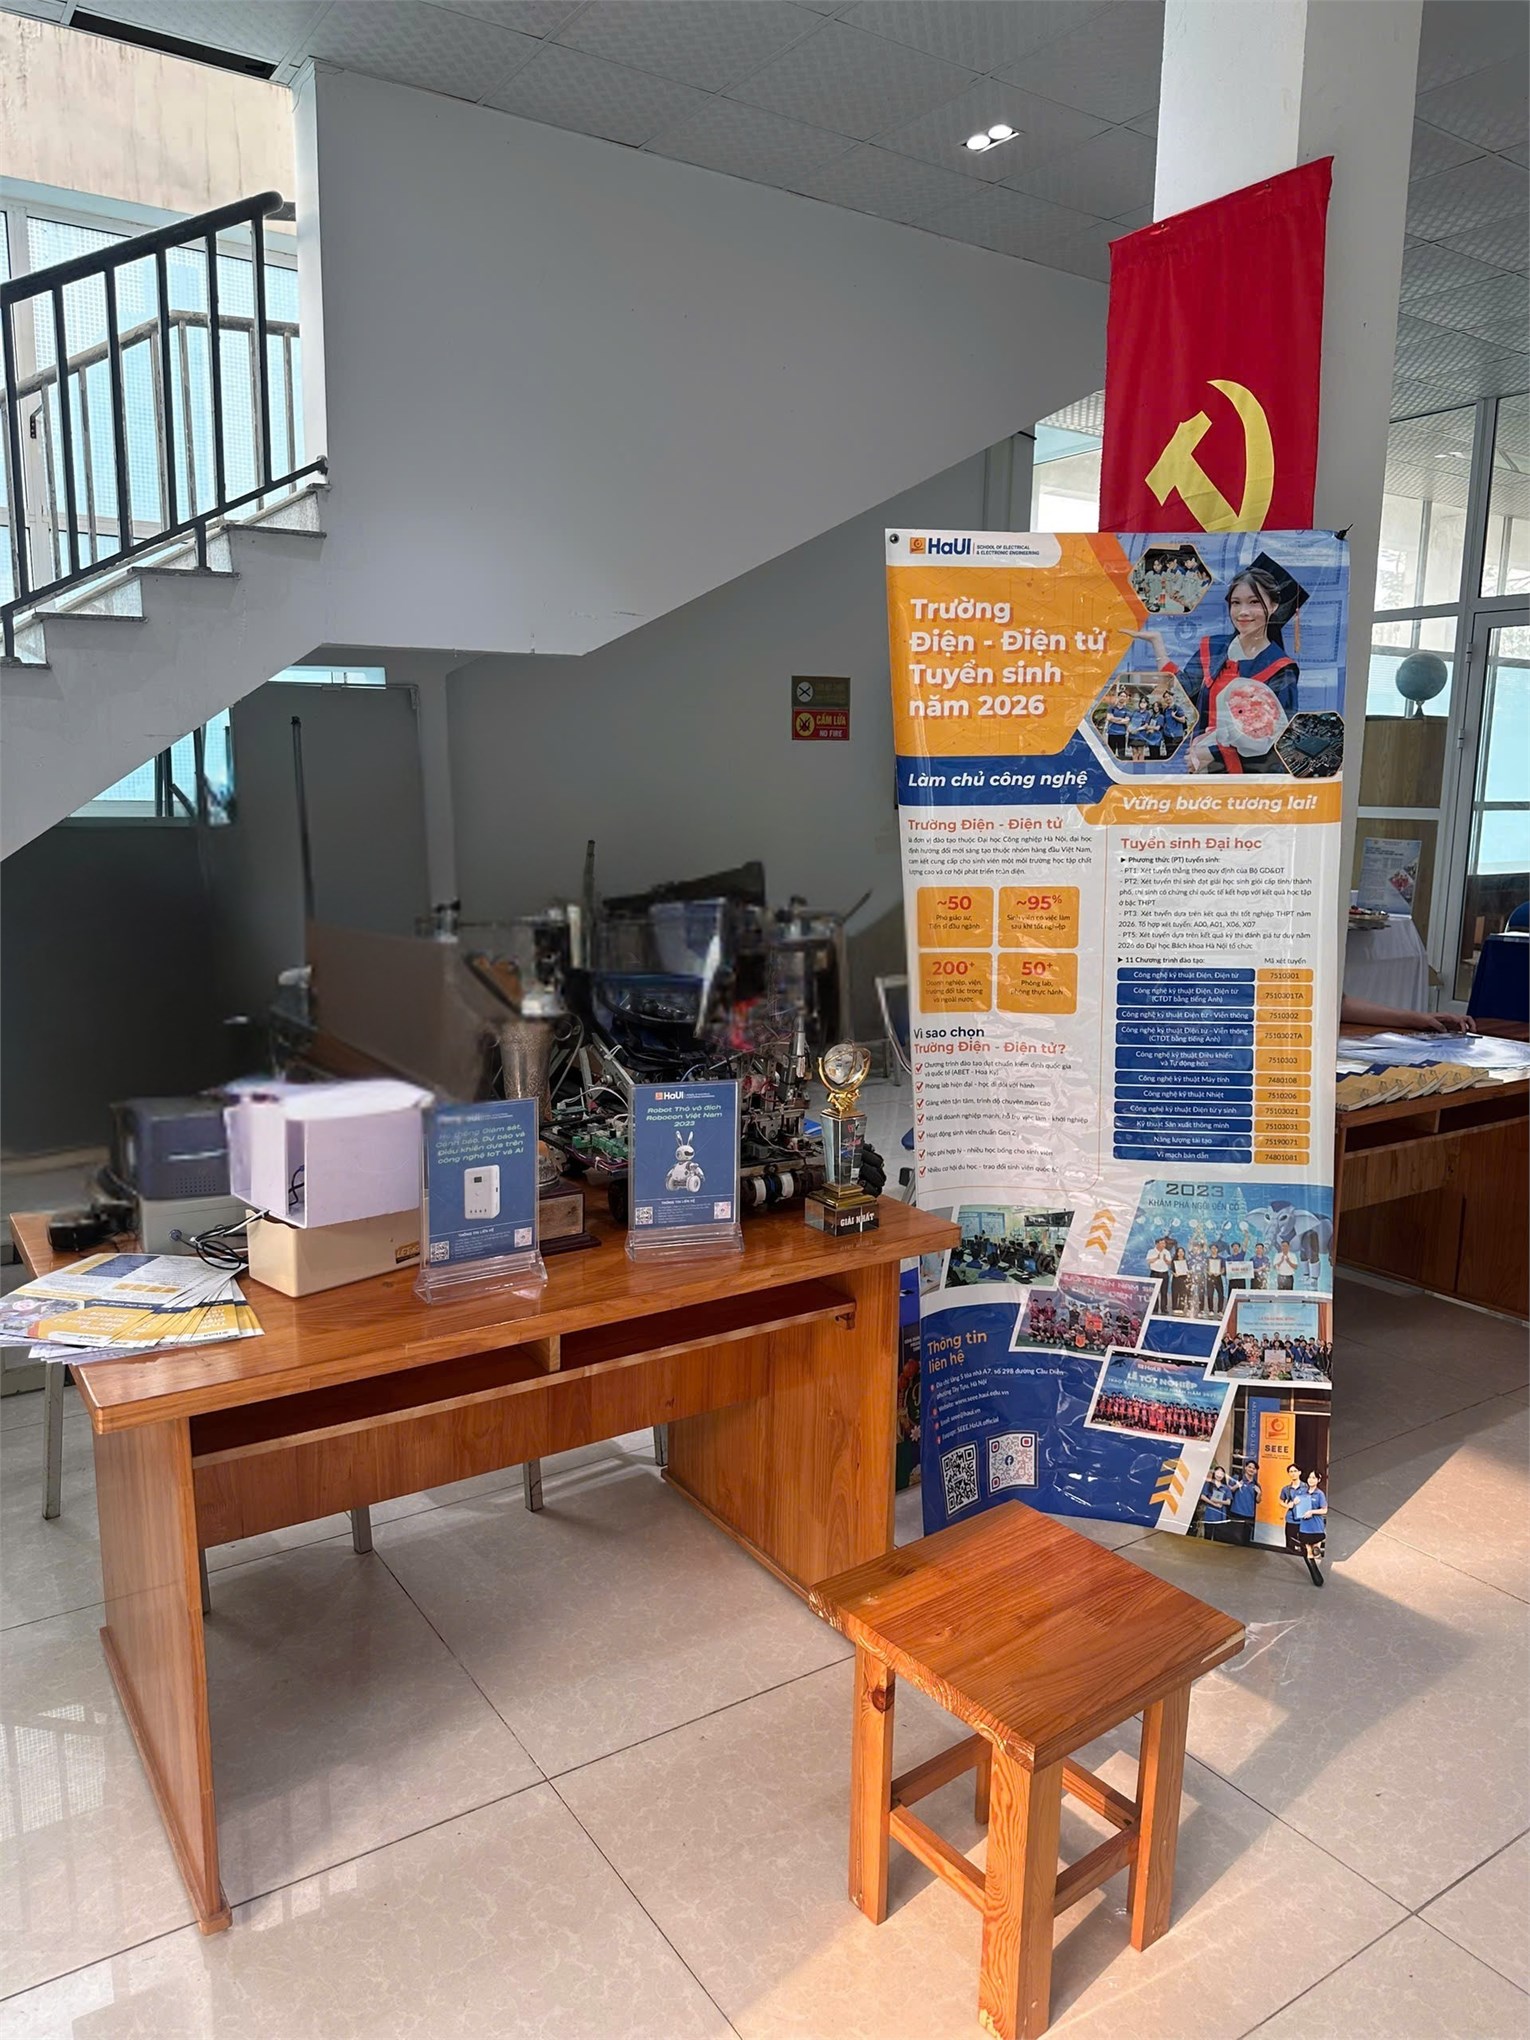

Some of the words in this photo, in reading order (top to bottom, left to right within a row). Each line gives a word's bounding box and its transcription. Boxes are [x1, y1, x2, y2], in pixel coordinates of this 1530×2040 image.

[928, 538, 971, 554] HaUI
[911, 597, 1010, 624] Trường
[910, 629, 974, 657] Điện
[1001, 627, 1066, 656] Điện
[1075, 627, 1106, 651] tử
[909, 660, 993, 689] Tuyển
[1003, 660, 1061, 684] sinh
[909, 695, 969, 716] năm
[978, 695, 1044, 715] 2026
[909, 772, 946, 787] Làm
[951, 771, 985, 786] chủ
[990, 772, 1035, 788] công
[1040, 771, 1088, 788] nghệ
[1123, 796, 1171, 813] Vững
[1176, 796, 1222, 810] bước
[1227, 798, 1282, 813] tương
[1288, 796, 1318, 809] lai!
[908, 819, 956, 833] Trường
[961, 819, 994, 832] Điện
[1008, 818, 1042, 832] Điện
[1047, 817, 1063, 829] tử
[1121, 837, 1165, 850] Tuyển
[1170, 838, 1200, 848] sinh
[1205, 838, 1229, 851] Đại
[1235, 838, 1262, 851] học
[914, 1028, 923, 1039] Vì
[926, 1029, 947, 1038] sao
[950, 1027, 984, 1039] chọn
[914, 1042, 954, 1054] Trường
[958, 1041, 990, 1053] Điện
[1004, 1042, 1036, 1055] Điện
[1041, 1042, 1066, 1054] tử?
[664, 1091, 683, 1100] HaUI
[1166, 1183, 1223, 1197] 2023
[841, 1215, 854, 1226] GIẢI
[928, 1335, 961, 1355] Thông
[966, 1330, 987, 1344] tin
[929, 1358, 947, 1374] liên
[950, 1350, 964, 1366] hệ
[1265, 1445, 1289, 1453] SEEE
